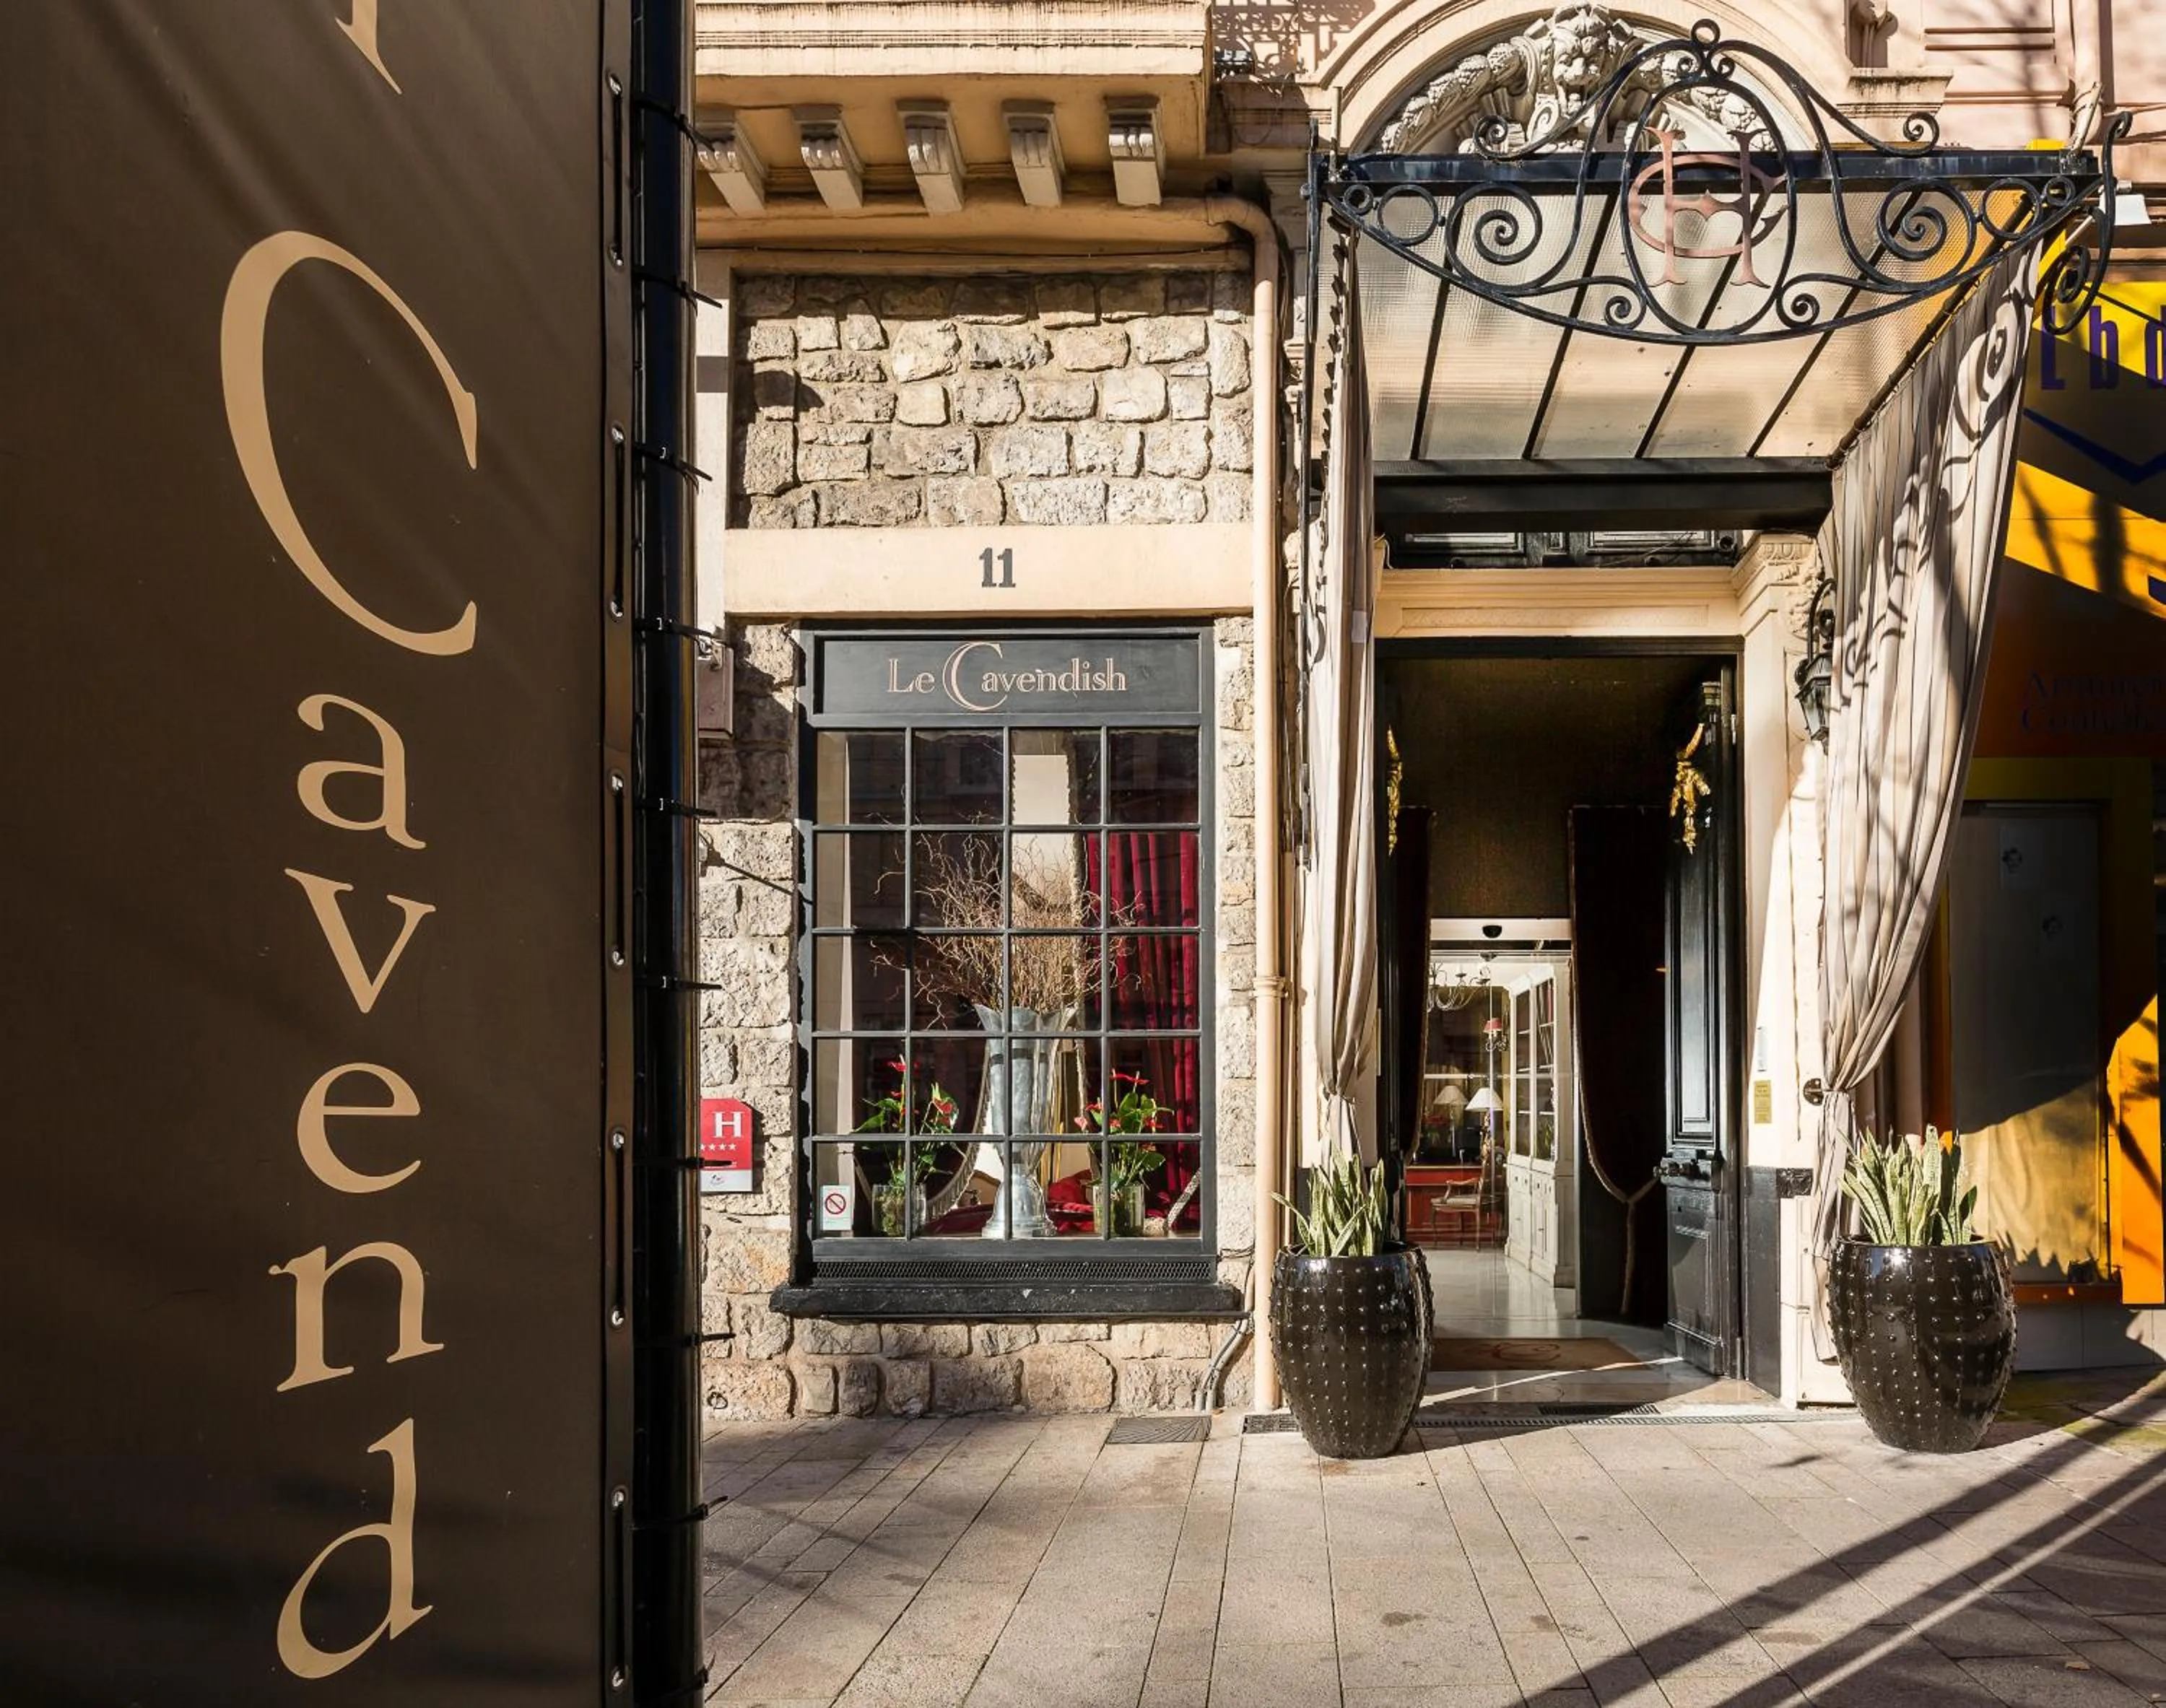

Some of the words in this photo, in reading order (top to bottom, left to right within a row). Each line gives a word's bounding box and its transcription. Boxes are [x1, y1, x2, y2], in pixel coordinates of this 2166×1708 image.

[979, 547, 1016, 588] 11
[887, 658, 935, 693] Le
[942, 641, 1127, 712] Cavendish
[713, 1110, 744, 1138] H
